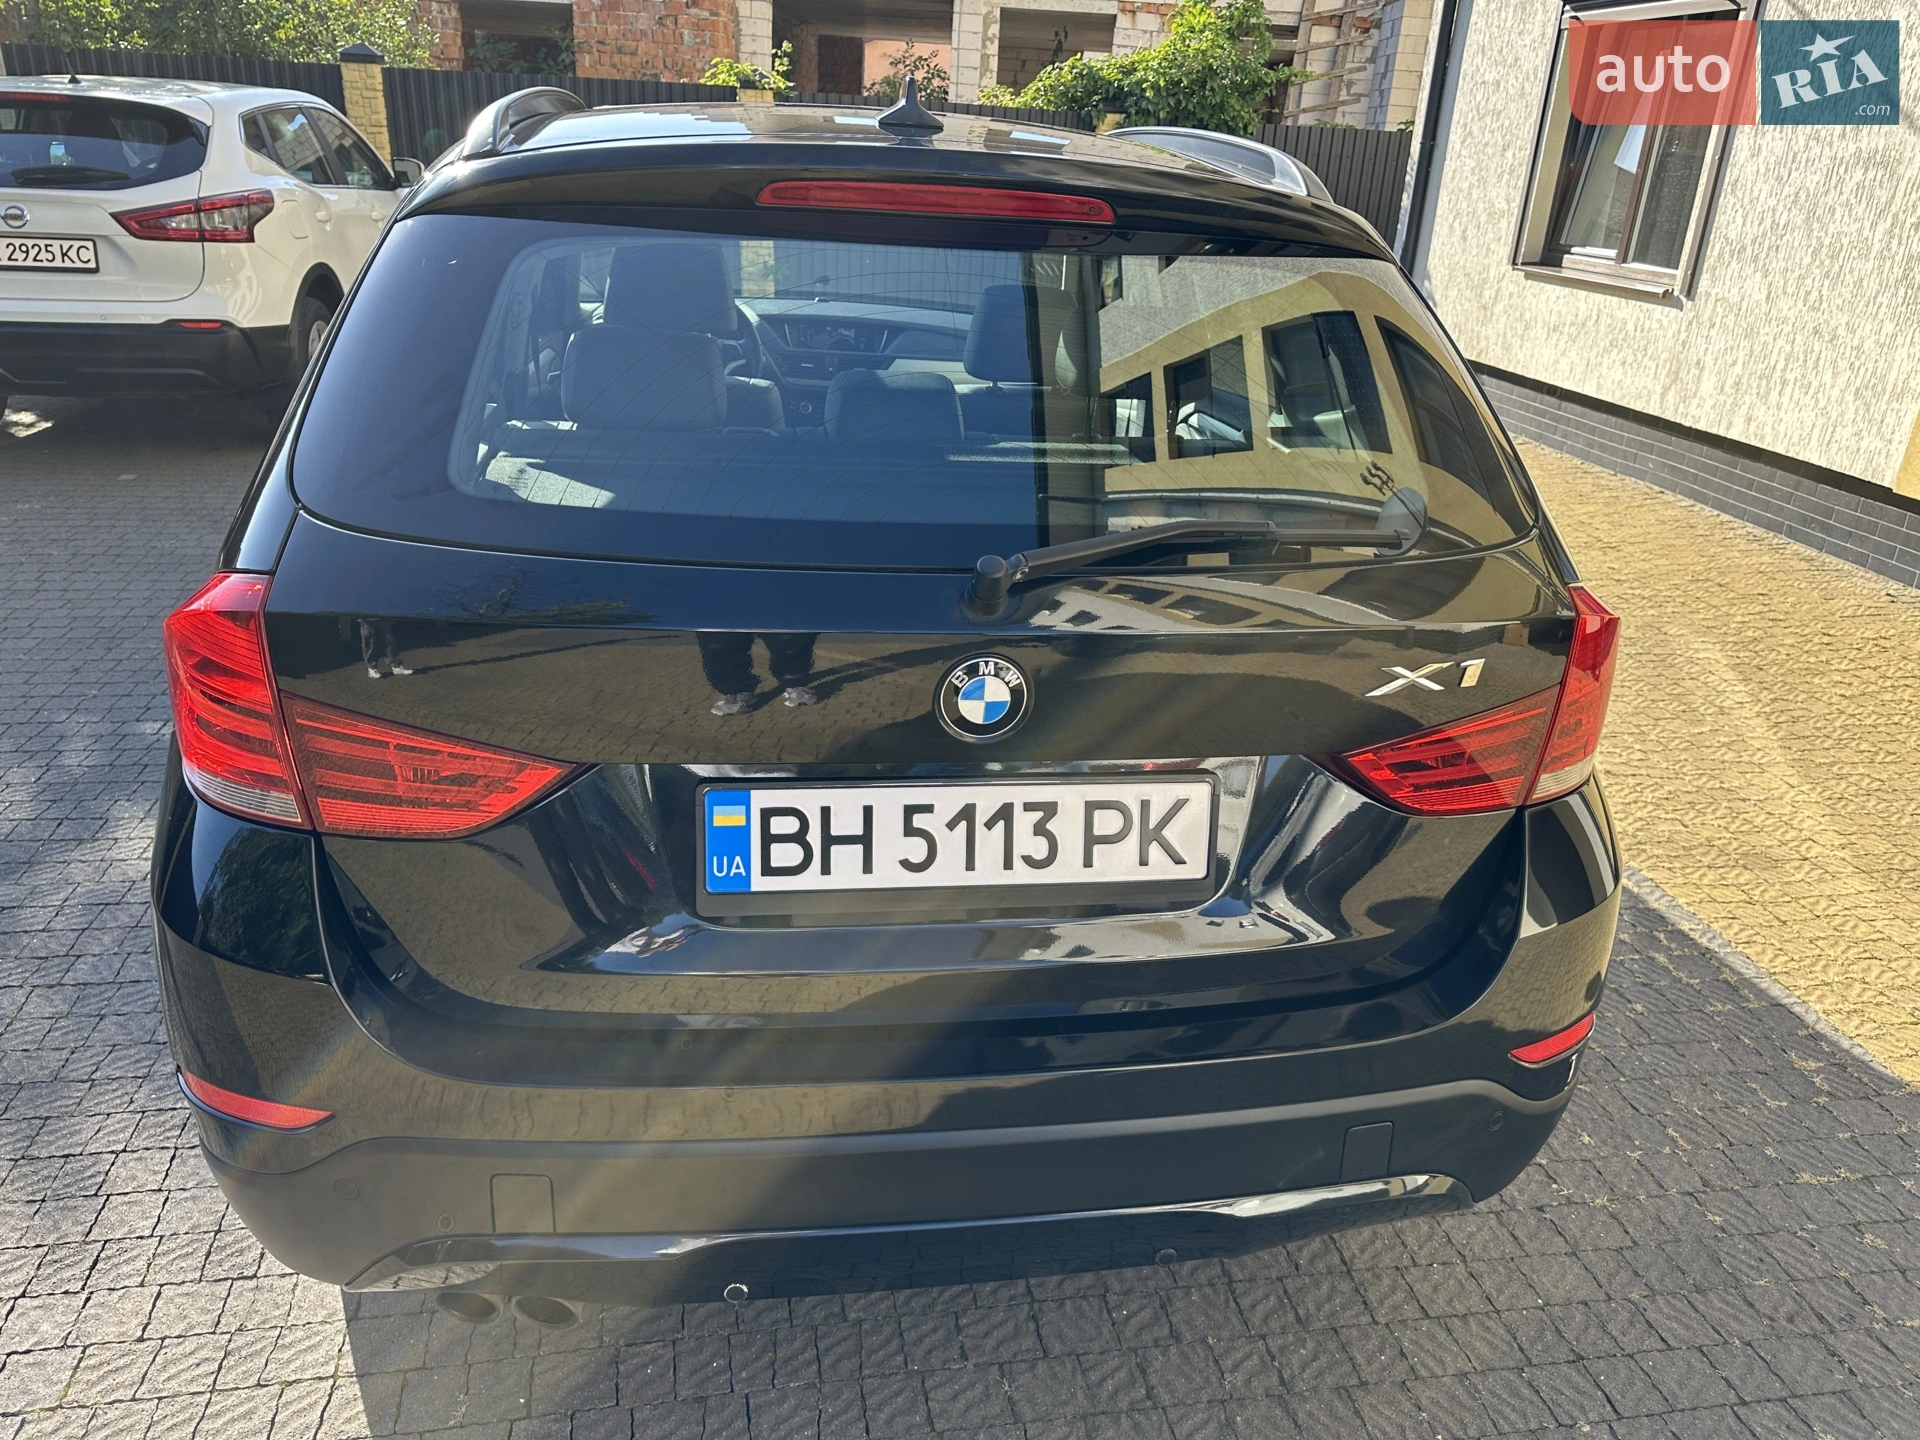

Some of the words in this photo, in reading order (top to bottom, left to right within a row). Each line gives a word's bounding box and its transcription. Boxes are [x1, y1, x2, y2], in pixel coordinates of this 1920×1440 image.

[5, 242, 56, 263] 2925
[59, 244, 91, 264] KC
[951, 661, 1021, 688] BMW
[1364, 658, 1486, 697] X1
[760, 804, 873, 877] BH
[899, 802, 1058, 873] 5113
[1083, 797, 1190, 868] PK
[713, 856, 746, 877] UA
